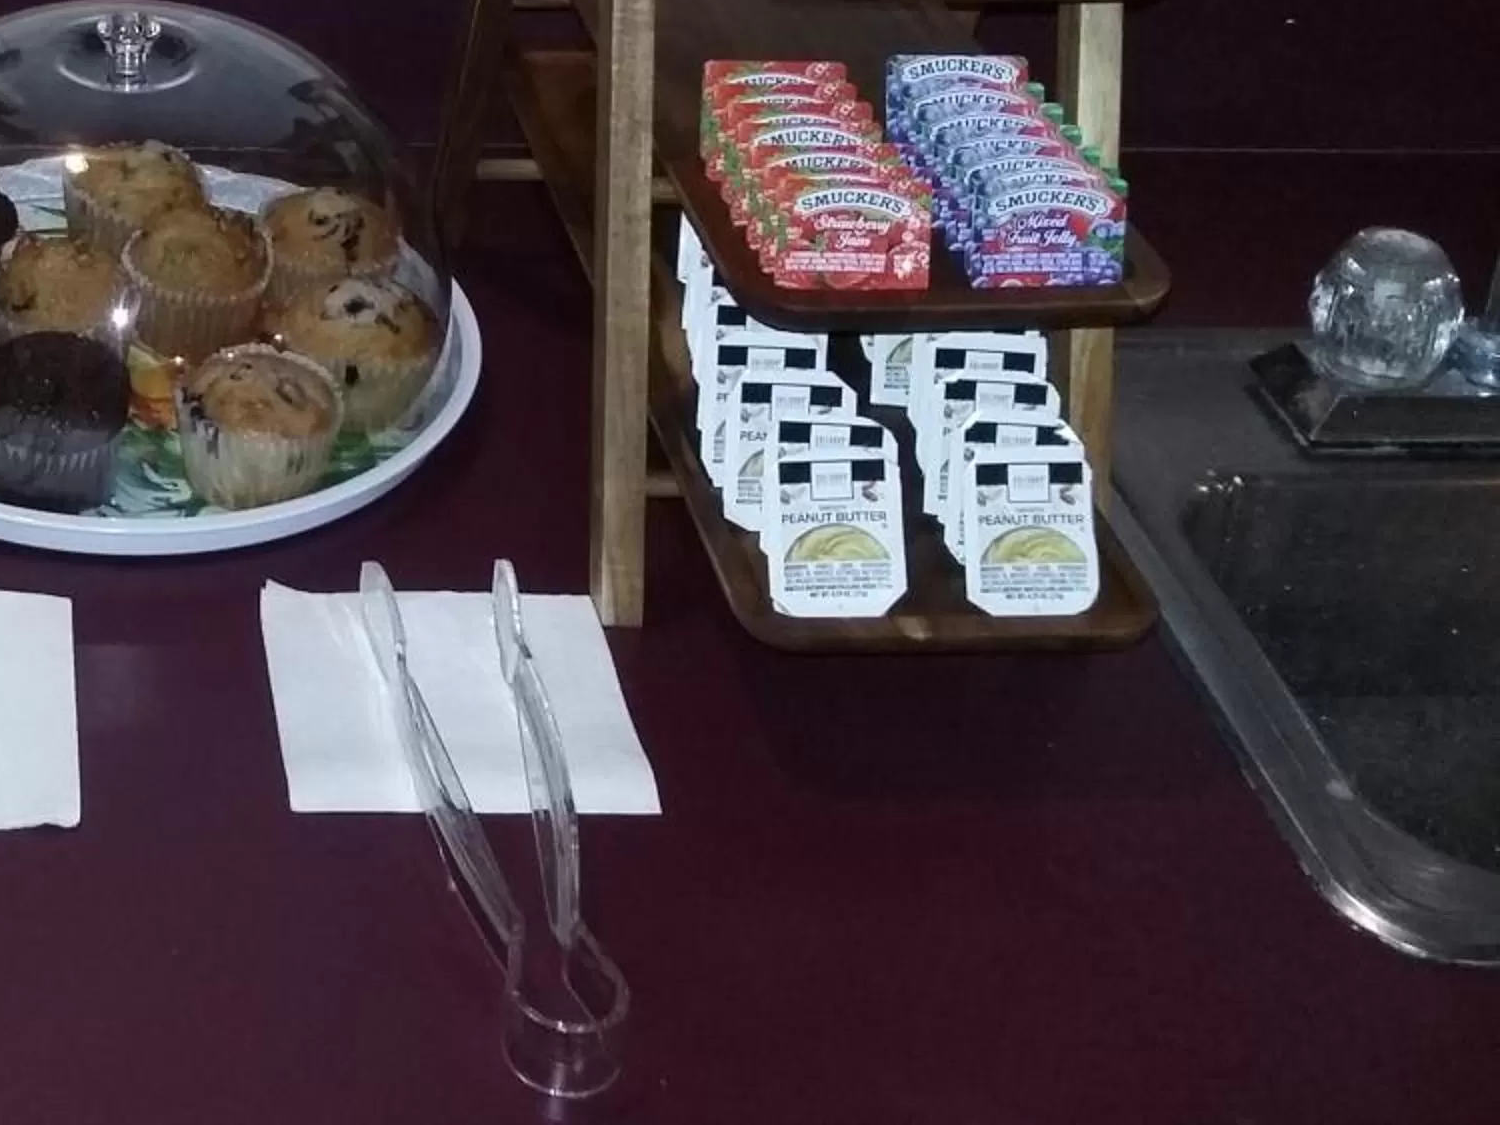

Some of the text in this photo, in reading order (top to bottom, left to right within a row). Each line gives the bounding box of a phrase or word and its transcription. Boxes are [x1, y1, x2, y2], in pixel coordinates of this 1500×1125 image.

[1018, 213, 1070, 229] Mixed
[834, 233, 872, 249] Jam
[1007, 229, 1077, 248] Fruit Jelly
[781, 510, 887, 524] PEANUT BUTTER
[978, 514, 1085, 526] PEANUT BUTTER
